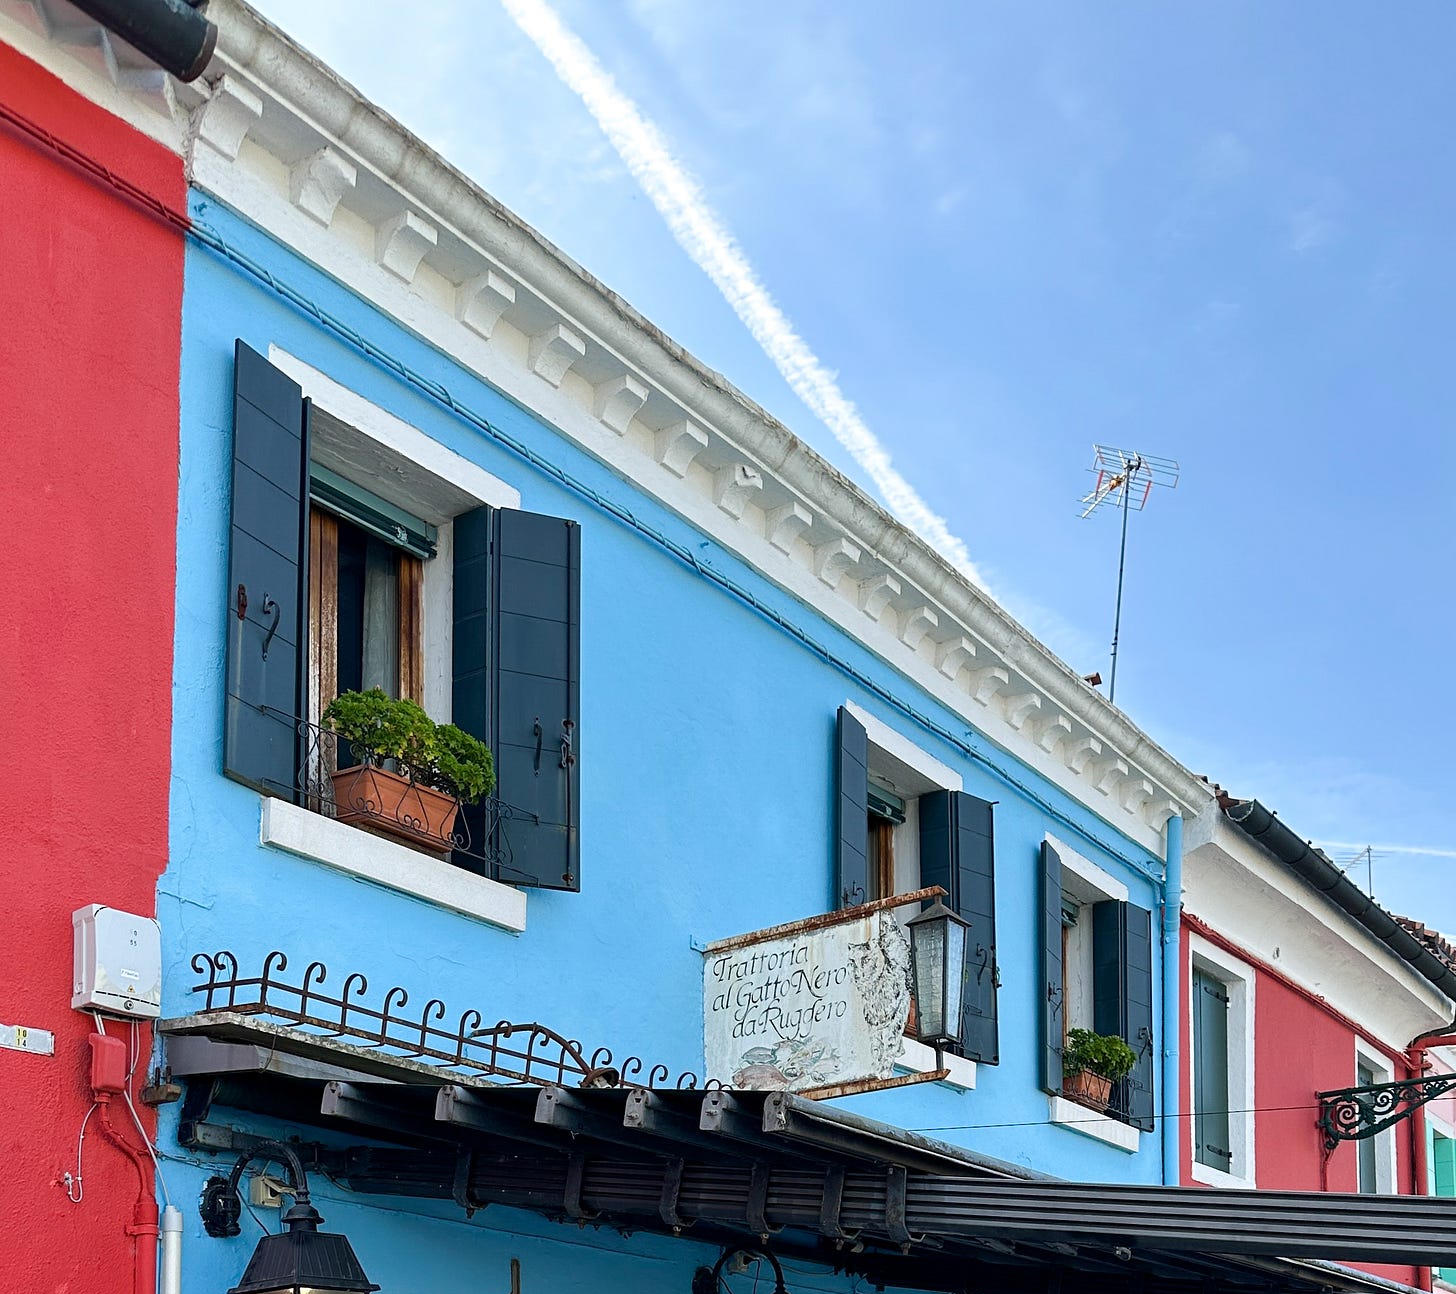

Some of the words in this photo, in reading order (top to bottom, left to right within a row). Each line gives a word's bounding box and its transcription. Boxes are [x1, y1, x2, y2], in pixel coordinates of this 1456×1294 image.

[713, 943, 808, 982] Trattoria
[712, 981, 734, 1012] al
[734, 976, 791, 1022] Gatto
[791, 965, 847, 998] Nero
[17, 1029, 28, 1038] 10
[732, 1005, 759, 1039] da
[758, 999, 847, 1041] Ruggero
[17, 1038, 27, 1047] 14
